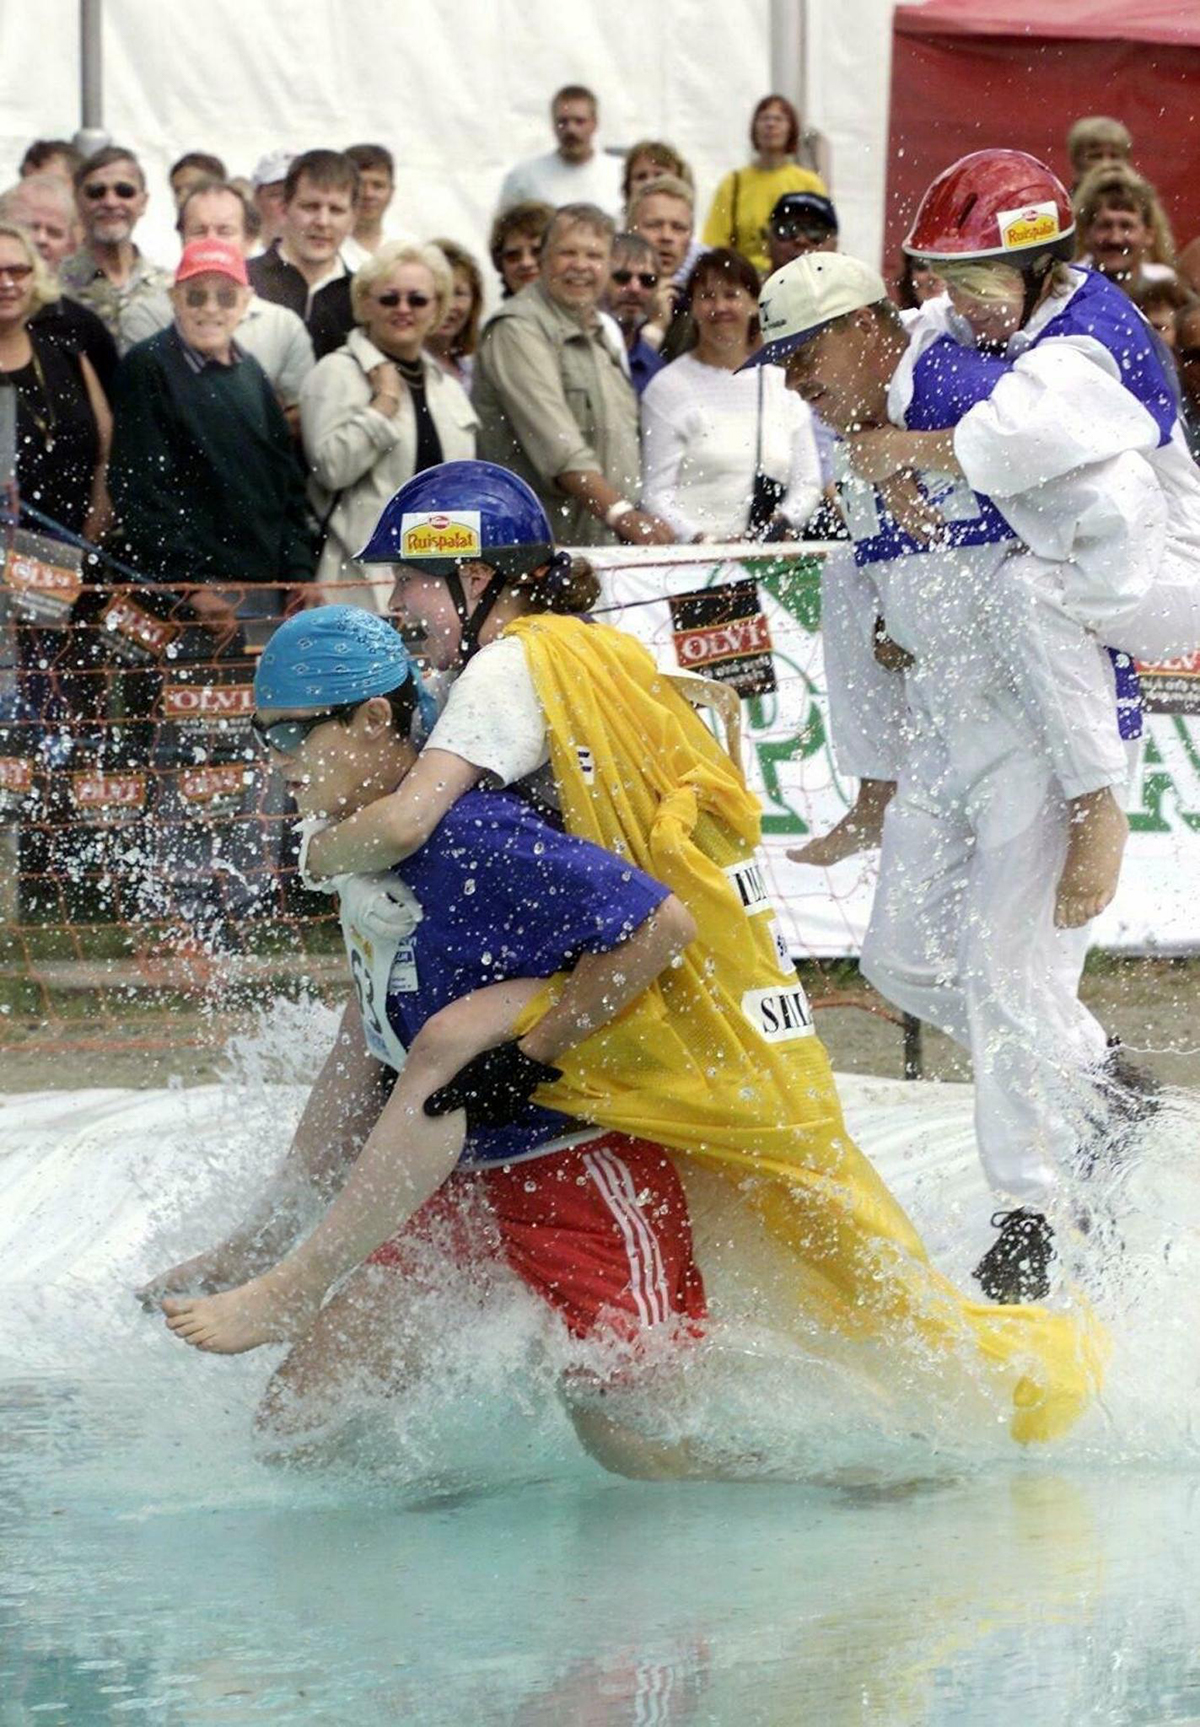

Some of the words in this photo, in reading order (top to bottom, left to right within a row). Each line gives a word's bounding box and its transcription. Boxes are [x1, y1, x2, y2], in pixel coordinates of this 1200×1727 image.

[407, 530, 474, 553] Ruispalat
[682, 623, 762, 660] OLVI
[173, 689, 252, 711] OLVI
